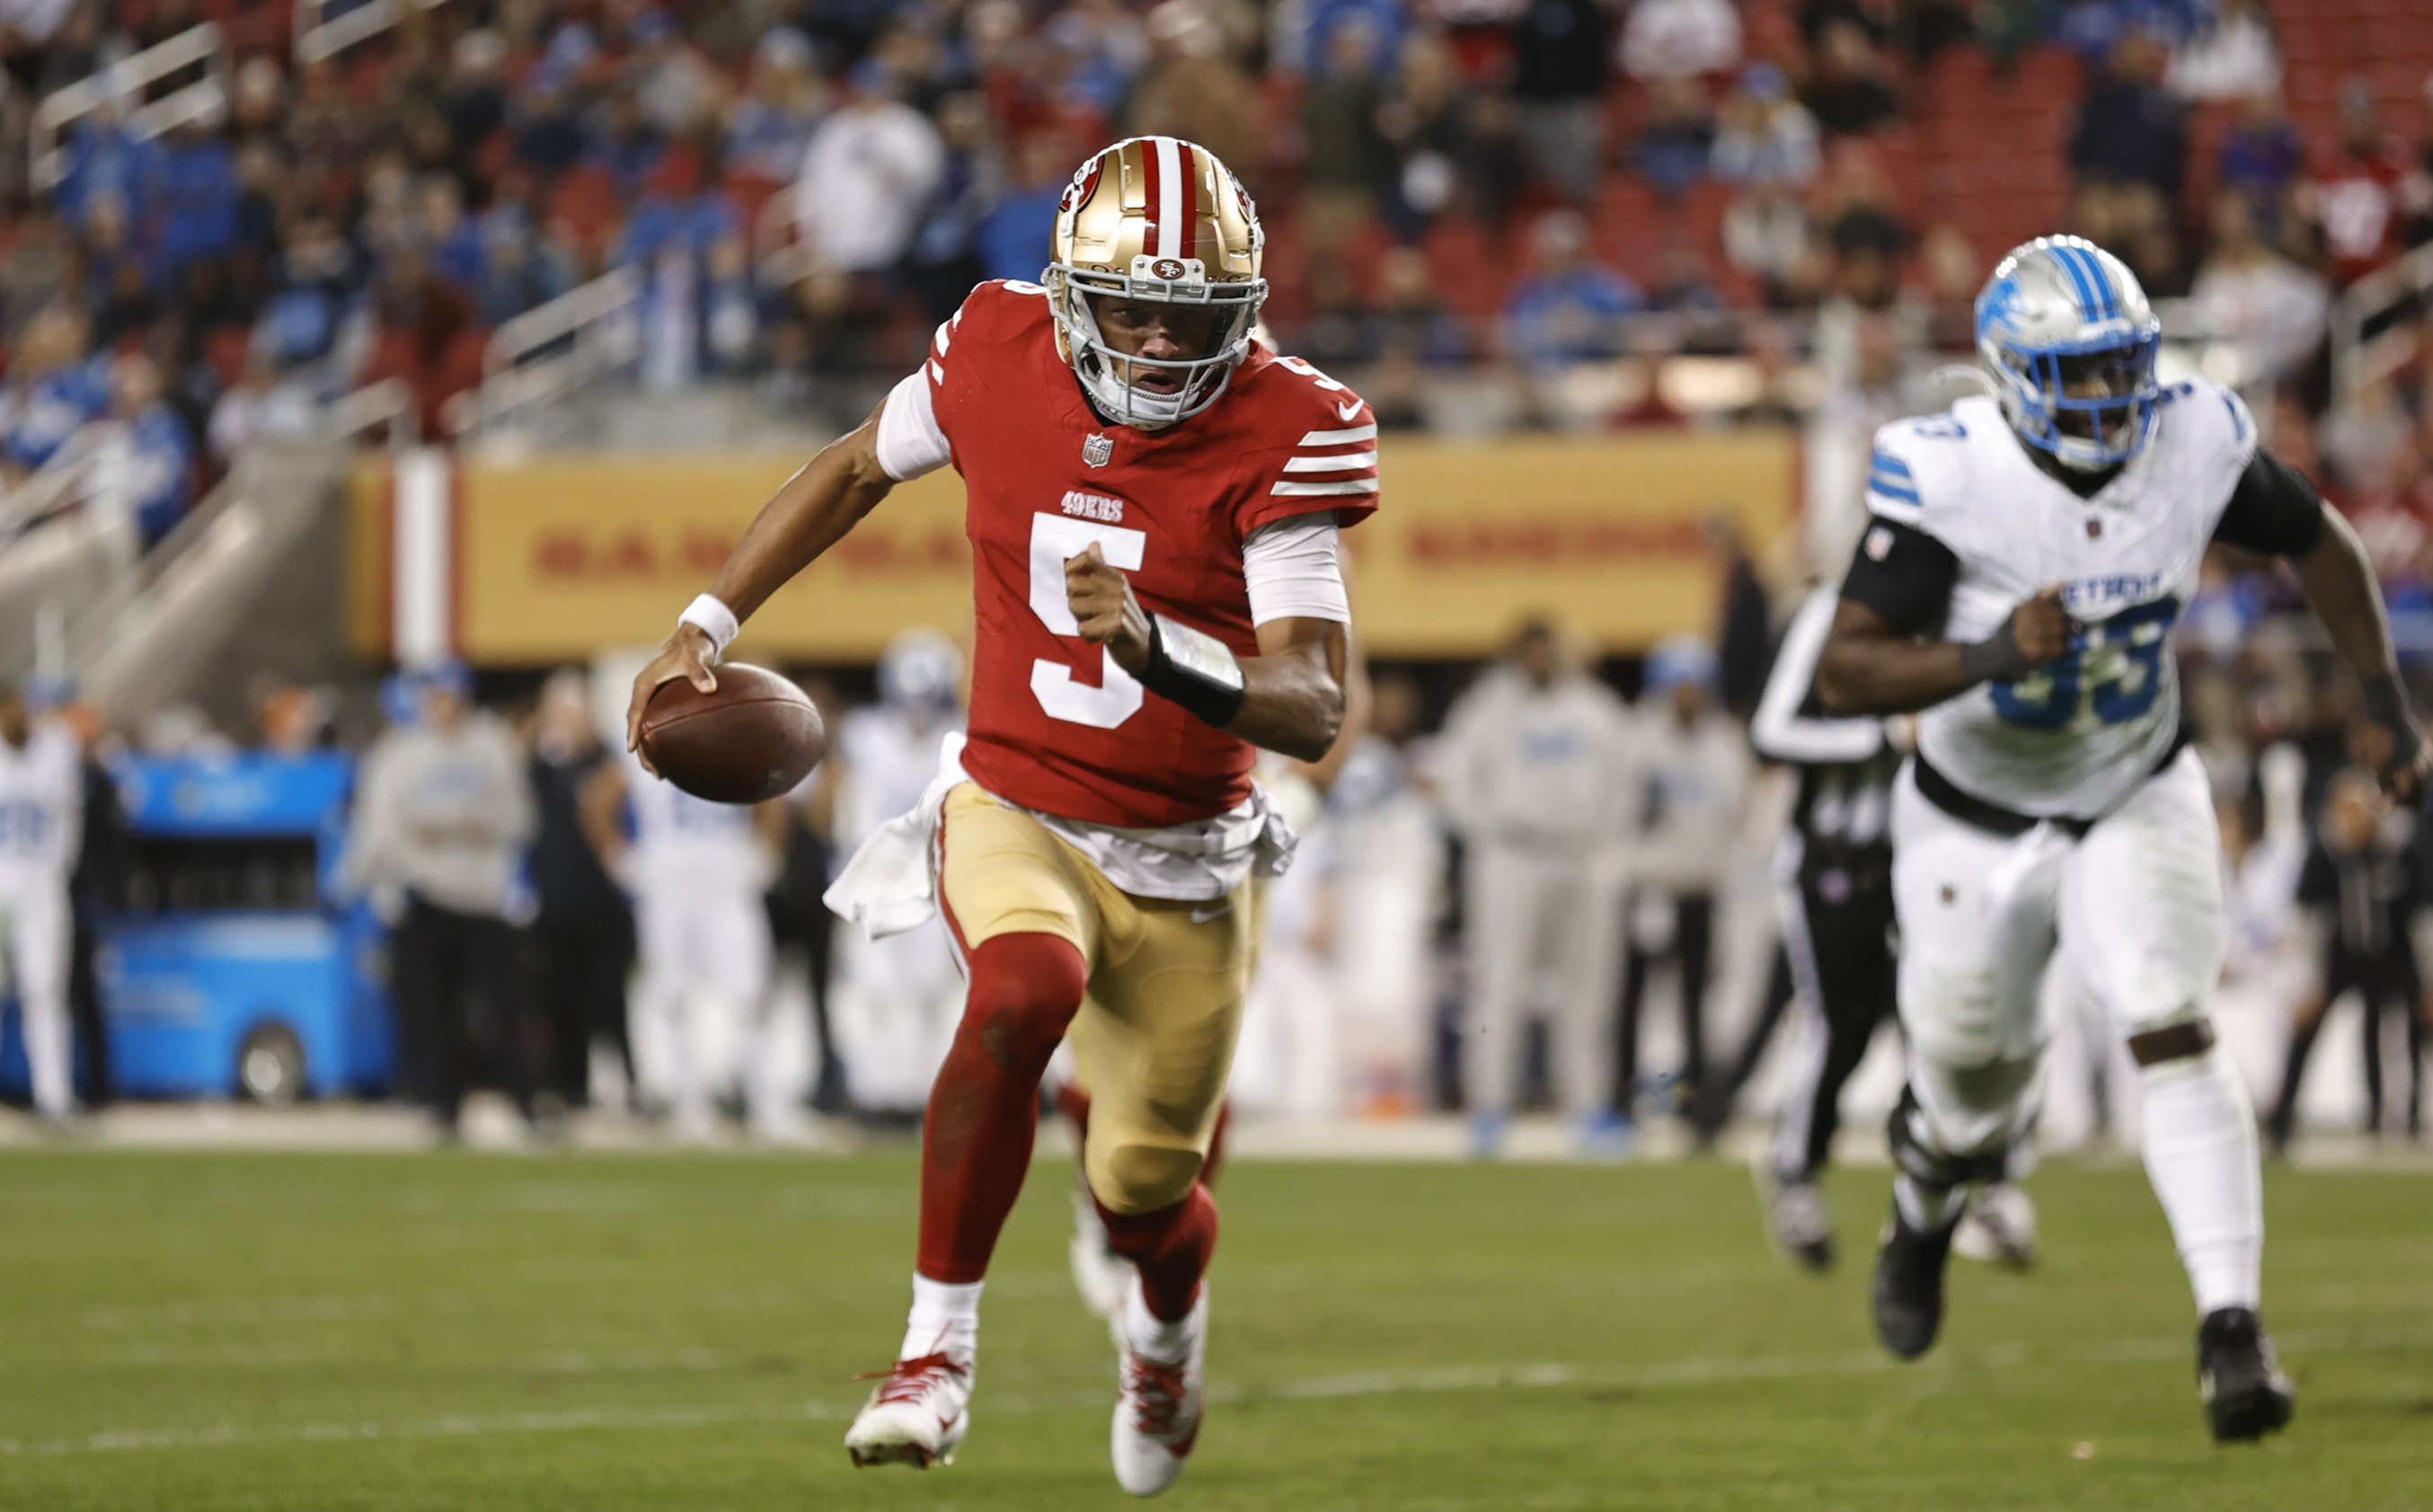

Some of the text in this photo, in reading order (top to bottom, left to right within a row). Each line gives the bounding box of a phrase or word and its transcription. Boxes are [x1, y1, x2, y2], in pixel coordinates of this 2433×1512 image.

[1060, 491, 1123, 523] 49ERS
[2064, 570, 2162, 606] ETROIT
[1029, 511, 1146, 729] 5
